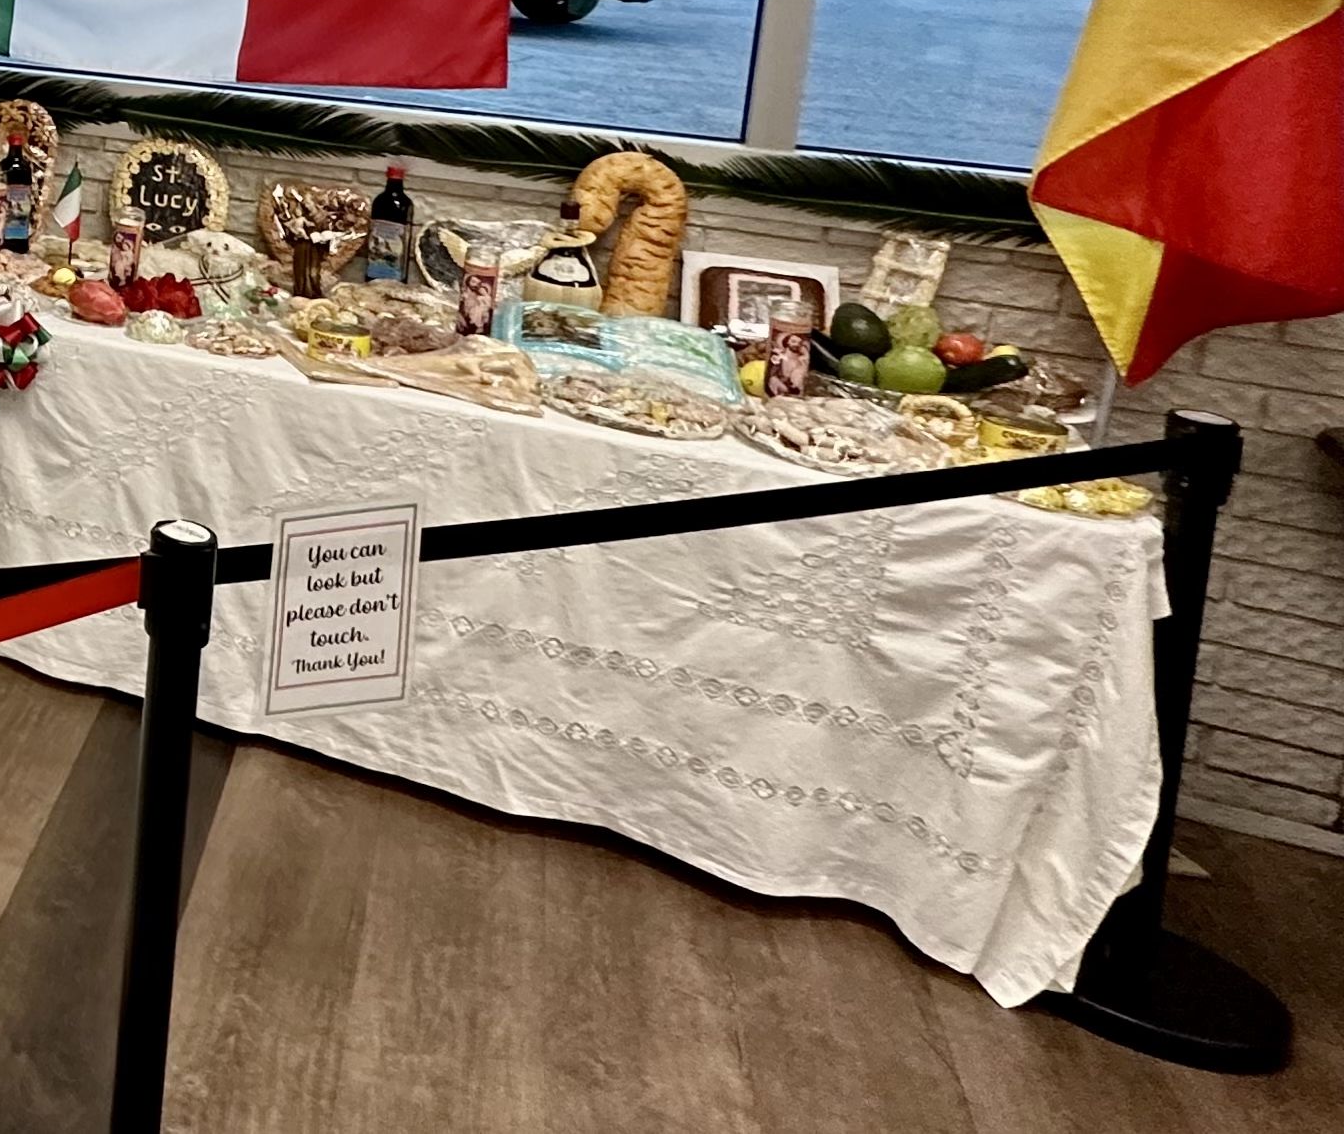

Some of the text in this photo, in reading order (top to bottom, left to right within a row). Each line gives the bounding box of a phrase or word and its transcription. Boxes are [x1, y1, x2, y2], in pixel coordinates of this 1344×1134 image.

[151, 164, 183, 184] St.
[139, 185, 199, 217] Lucy
[308, 540, 388, 569] You can
[306, 566, 384, 593] look but
[285, 592, 400, 627] please don't
[309, 626, 370, 648] touch.
[290, 649, 386, 675] Thank You!
